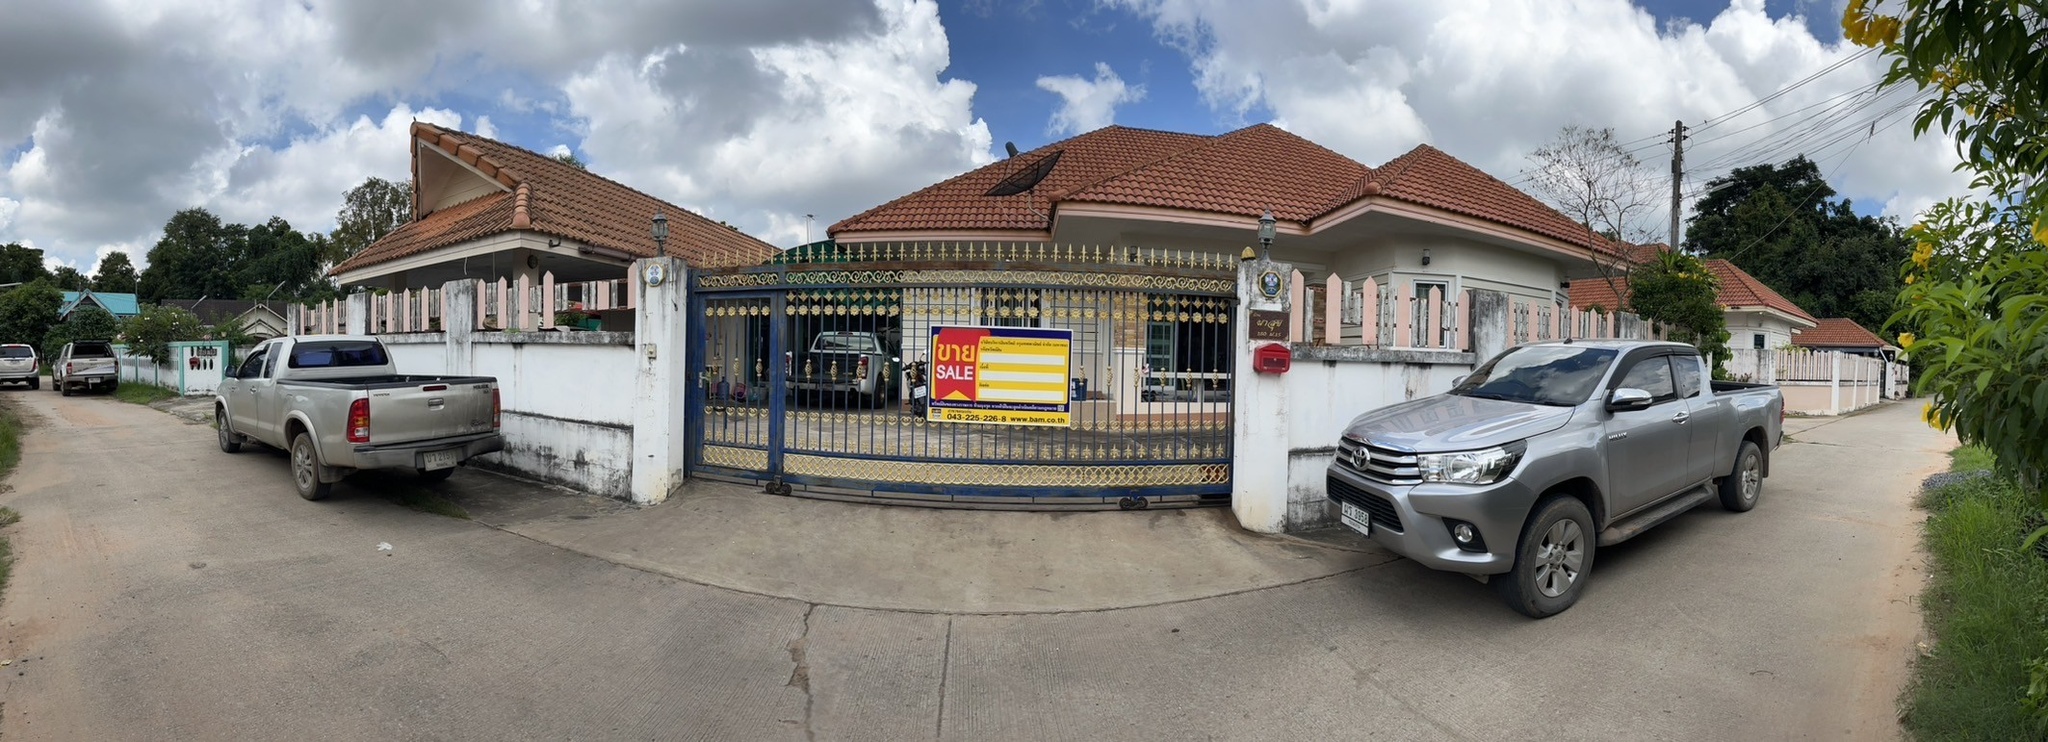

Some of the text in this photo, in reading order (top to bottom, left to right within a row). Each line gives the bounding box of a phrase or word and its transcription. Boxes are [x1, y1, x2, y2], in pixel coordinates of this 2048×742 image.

[938, 344, 975, 362] ขาย
[936, 364, 973, 380] SALE
[946, 413, 1007, 422] 043-225-226-8
